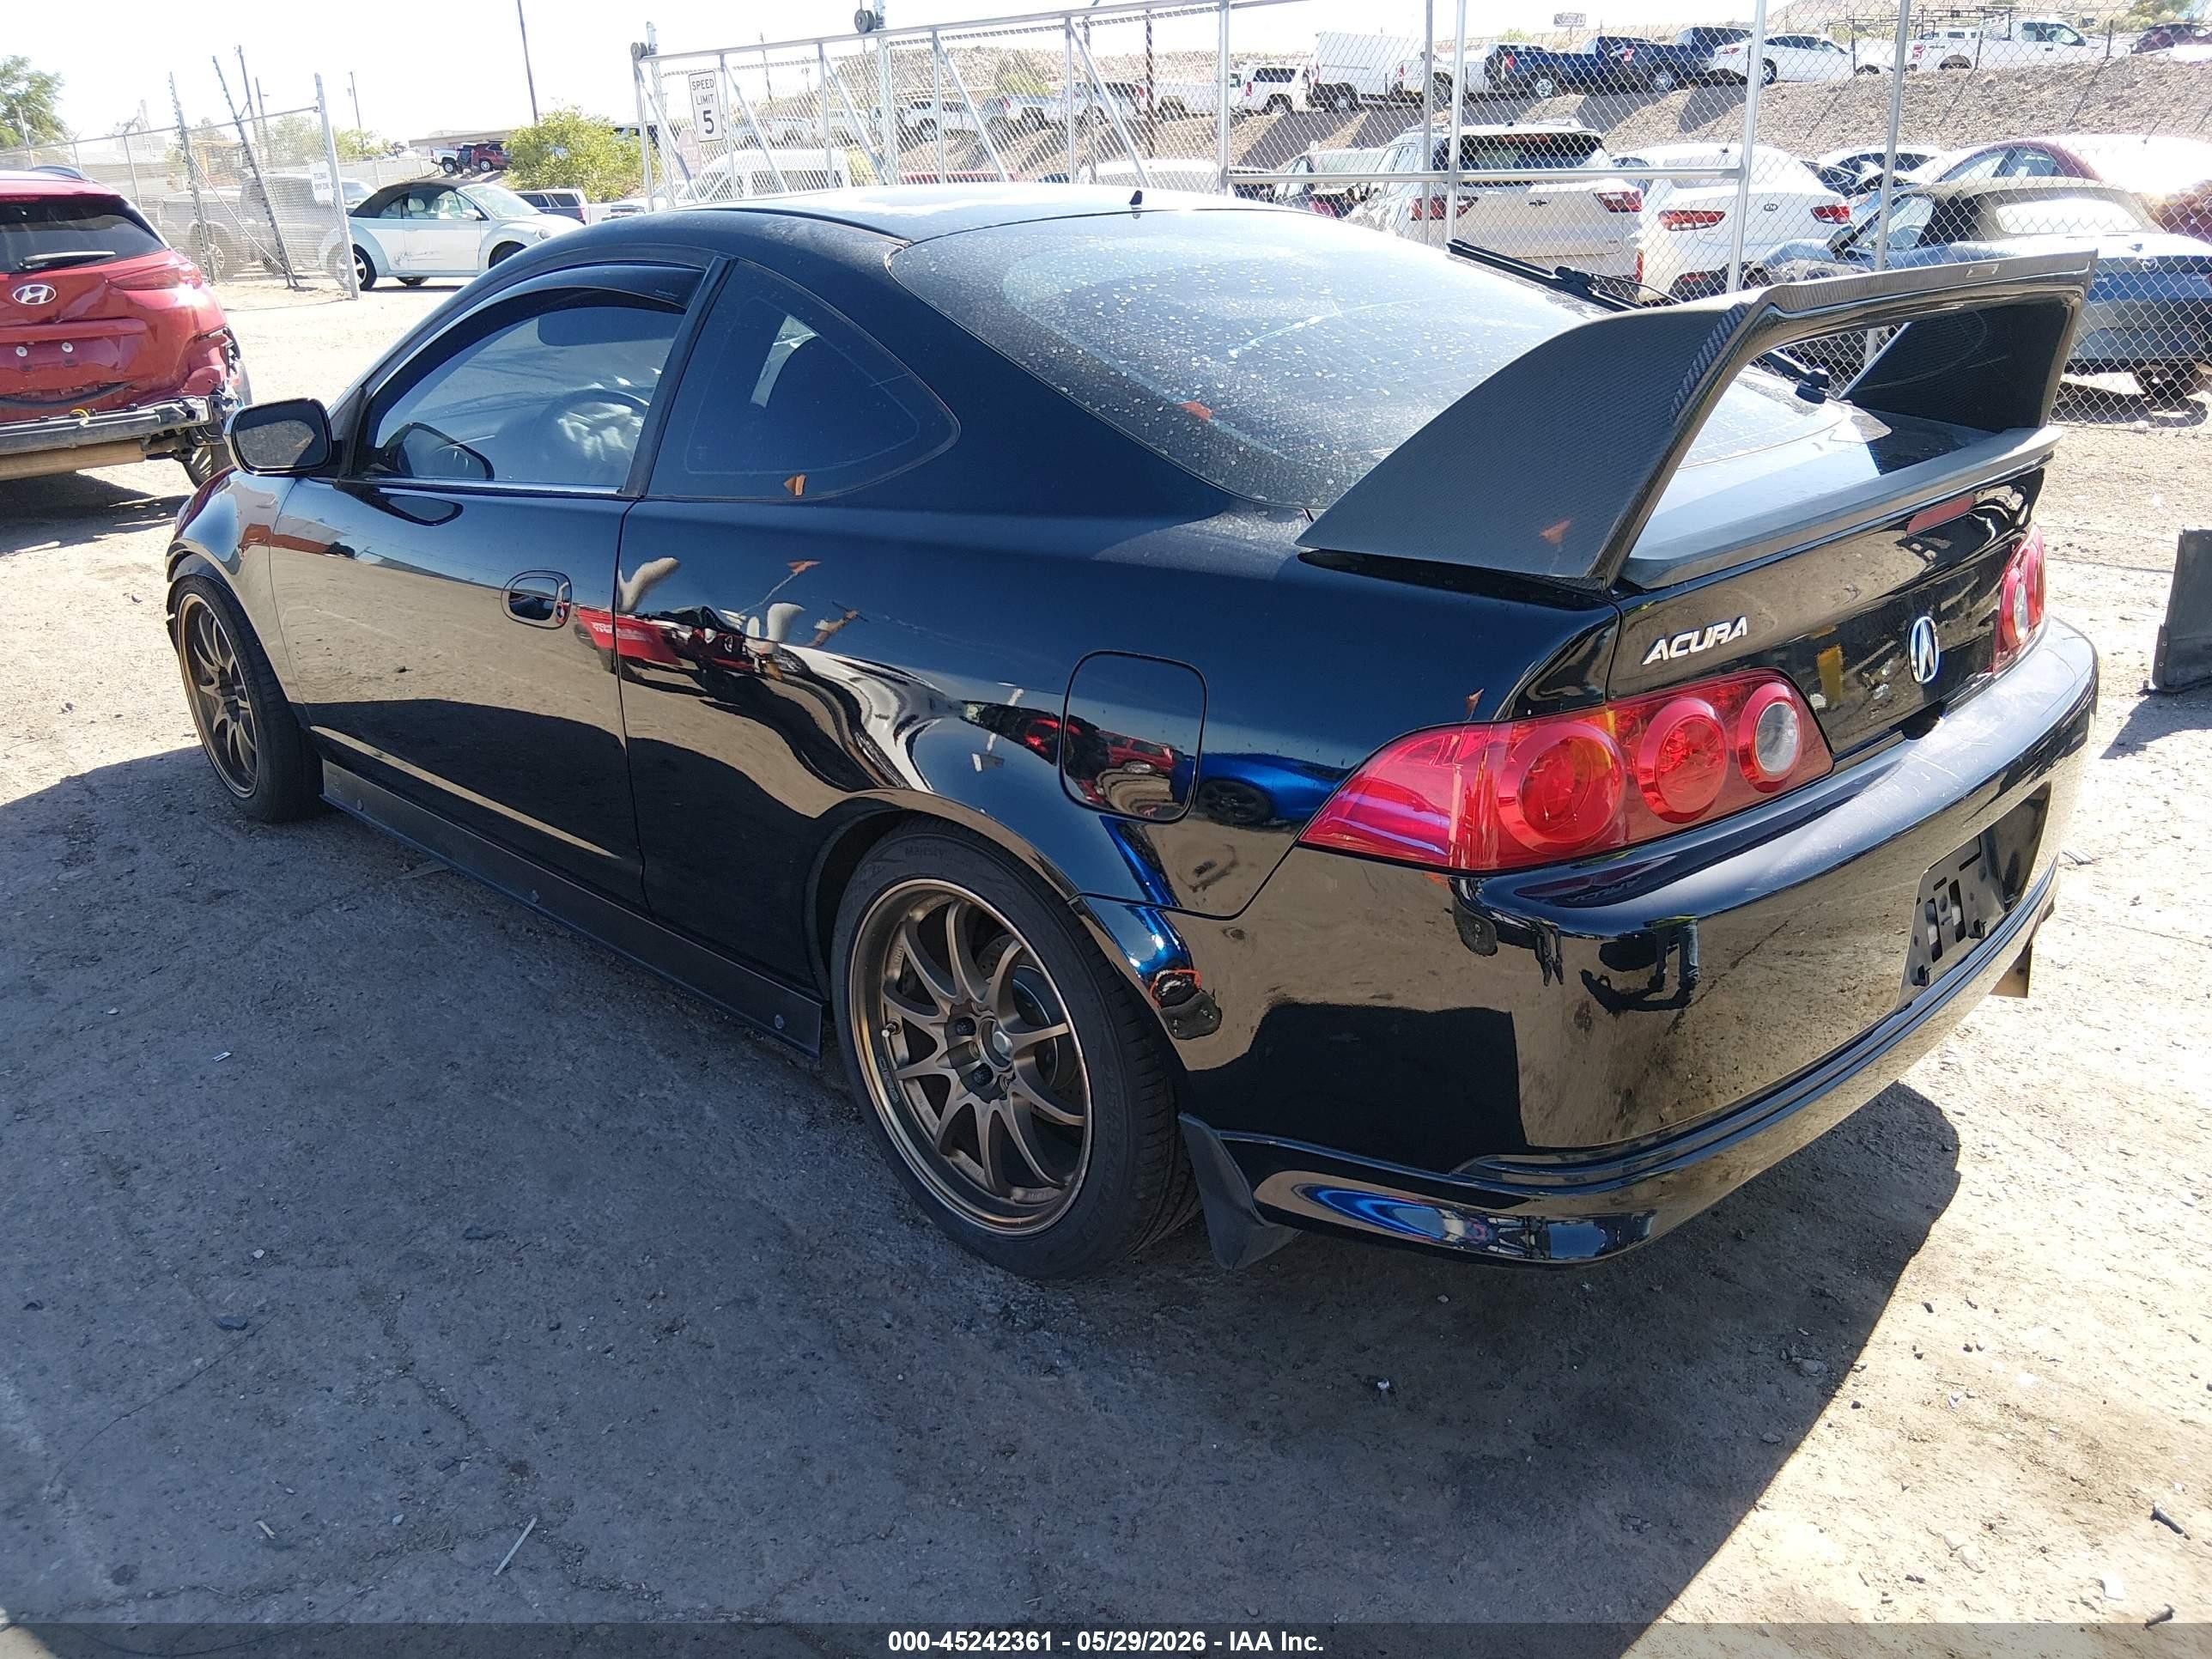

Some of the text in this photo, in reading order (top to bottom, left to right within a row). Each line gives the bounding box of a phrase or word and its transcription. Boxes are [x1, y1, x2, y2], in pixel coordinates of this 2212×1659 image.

[691, 78, 714, 91] SPEED
[696, 94, 714, 106] LIMIT
[702, 109, 714, 135] 5
[1641, 616, 1747, 665] ACURA
